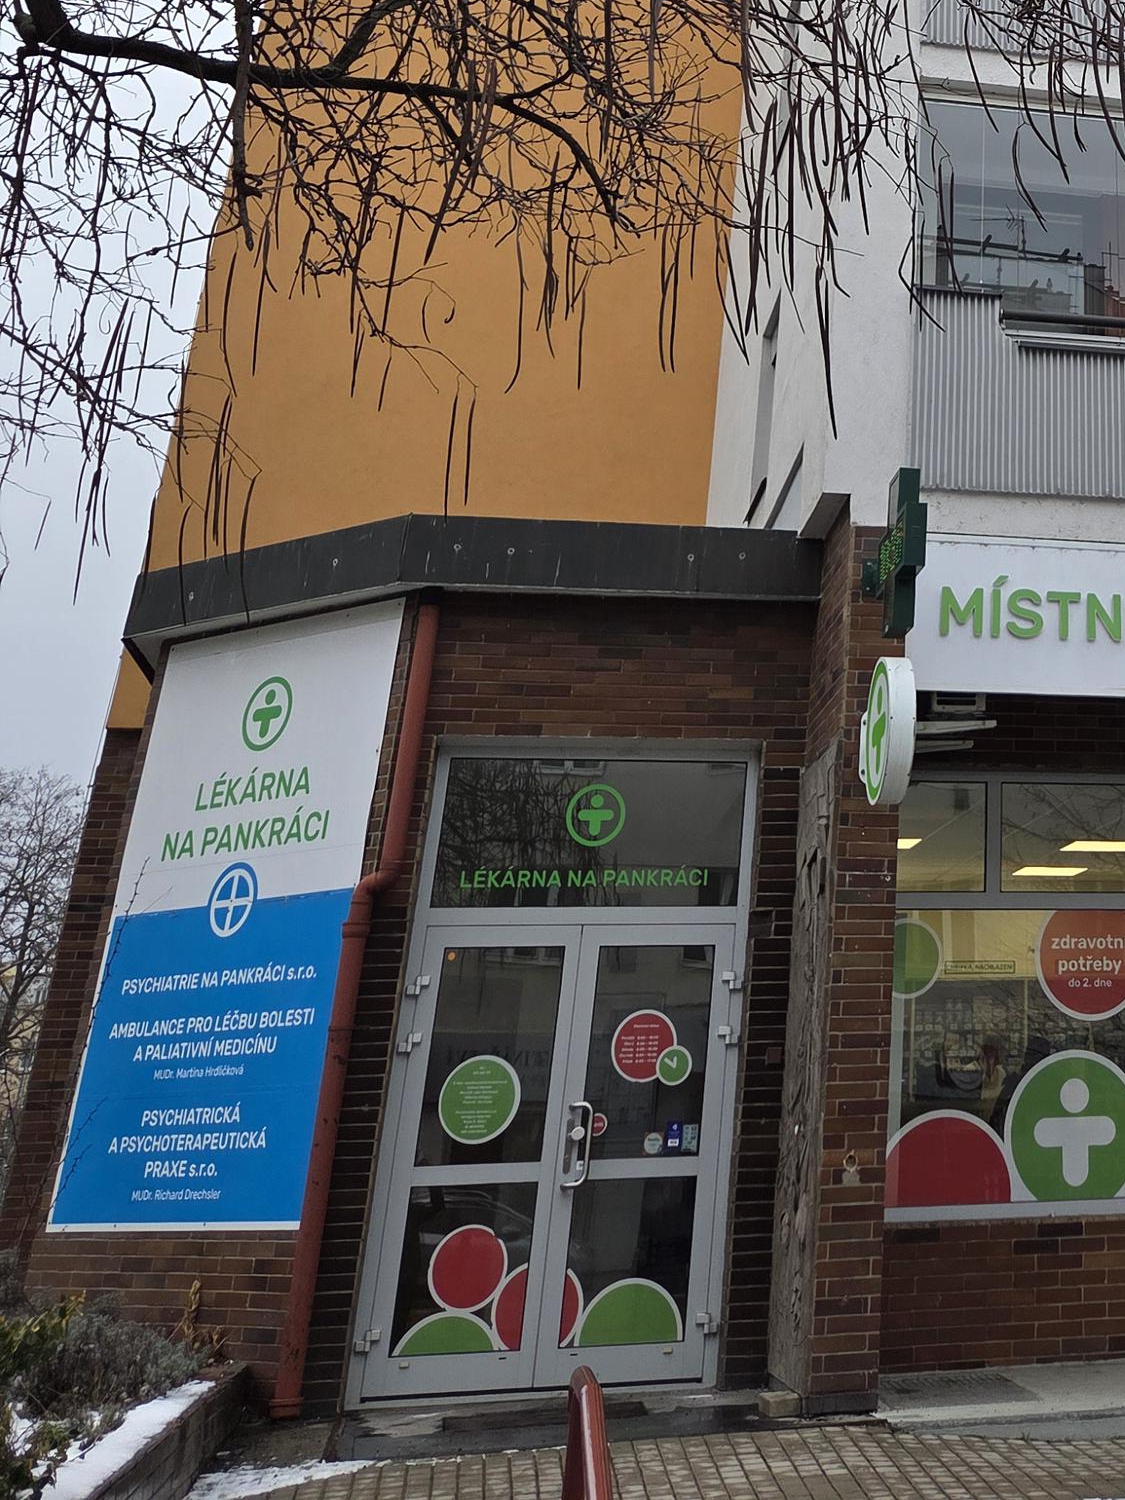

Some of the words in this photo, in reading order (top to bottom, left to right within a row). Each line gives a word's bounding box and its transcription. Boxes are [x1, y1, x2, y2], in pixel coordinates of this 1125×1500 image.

[195, 766, 310, 811] LÉKÁRNA
[161, 830, 194, 862] NA
[200, 805, 330, 857] PANKRÁCI
[460, 865, 562, 889] LÉKÁRNA
[567, 870, 597, 888] NA
[602, 864, 709, 887] PANKRÁCI
[1058, 955, 1122, 975] potřeby
[121, 972, 200, 996] PSYCHIATRIE
[201, 972, 219, 989] NA
[220, 961, 286, 987] PANKRÁCI
[286, 965, 318, 981] s.r.o.
[1068, 978, 1081, 988] do
[1082, 977, 1092, 988] 2.
[1094, 978, 1113, 988] dne
[109, 1018, 185, 1040] AMBULANCE
[186, 1016, 213, 1034] PRO
[214, 1010, 257, 1032] LÉČBU
[259, 1007, 316, 1029] BOLESTI
[133, 1046, 143, 1062] A
[144, 1036, 213, 1061] PALIATIVNÍ
[213, 1033, 278, 1057] MEDICÍNU
[153, 1069, 174, 1081] MUDr.
[176, 1067, 204, 1079] Martina
[204, 1064, 244, 1077] Hrdličková
[141, 1101, 241, 1127] PSYCHIATRICKÁ
[108, 1137, 118, 1154] A
[119, 1126, 268, 1153] PSYCHOTERAPEUTICKÁ
[144, 1159, 188, 1178] PRAXE
[188, 1162, 218, 1177] s.r.o.
[131, 1189, 153, 1201] MUDr.
[154, 1188, 184, 1200] Richard
[184, 1188, 222, 1200] Drechsler
